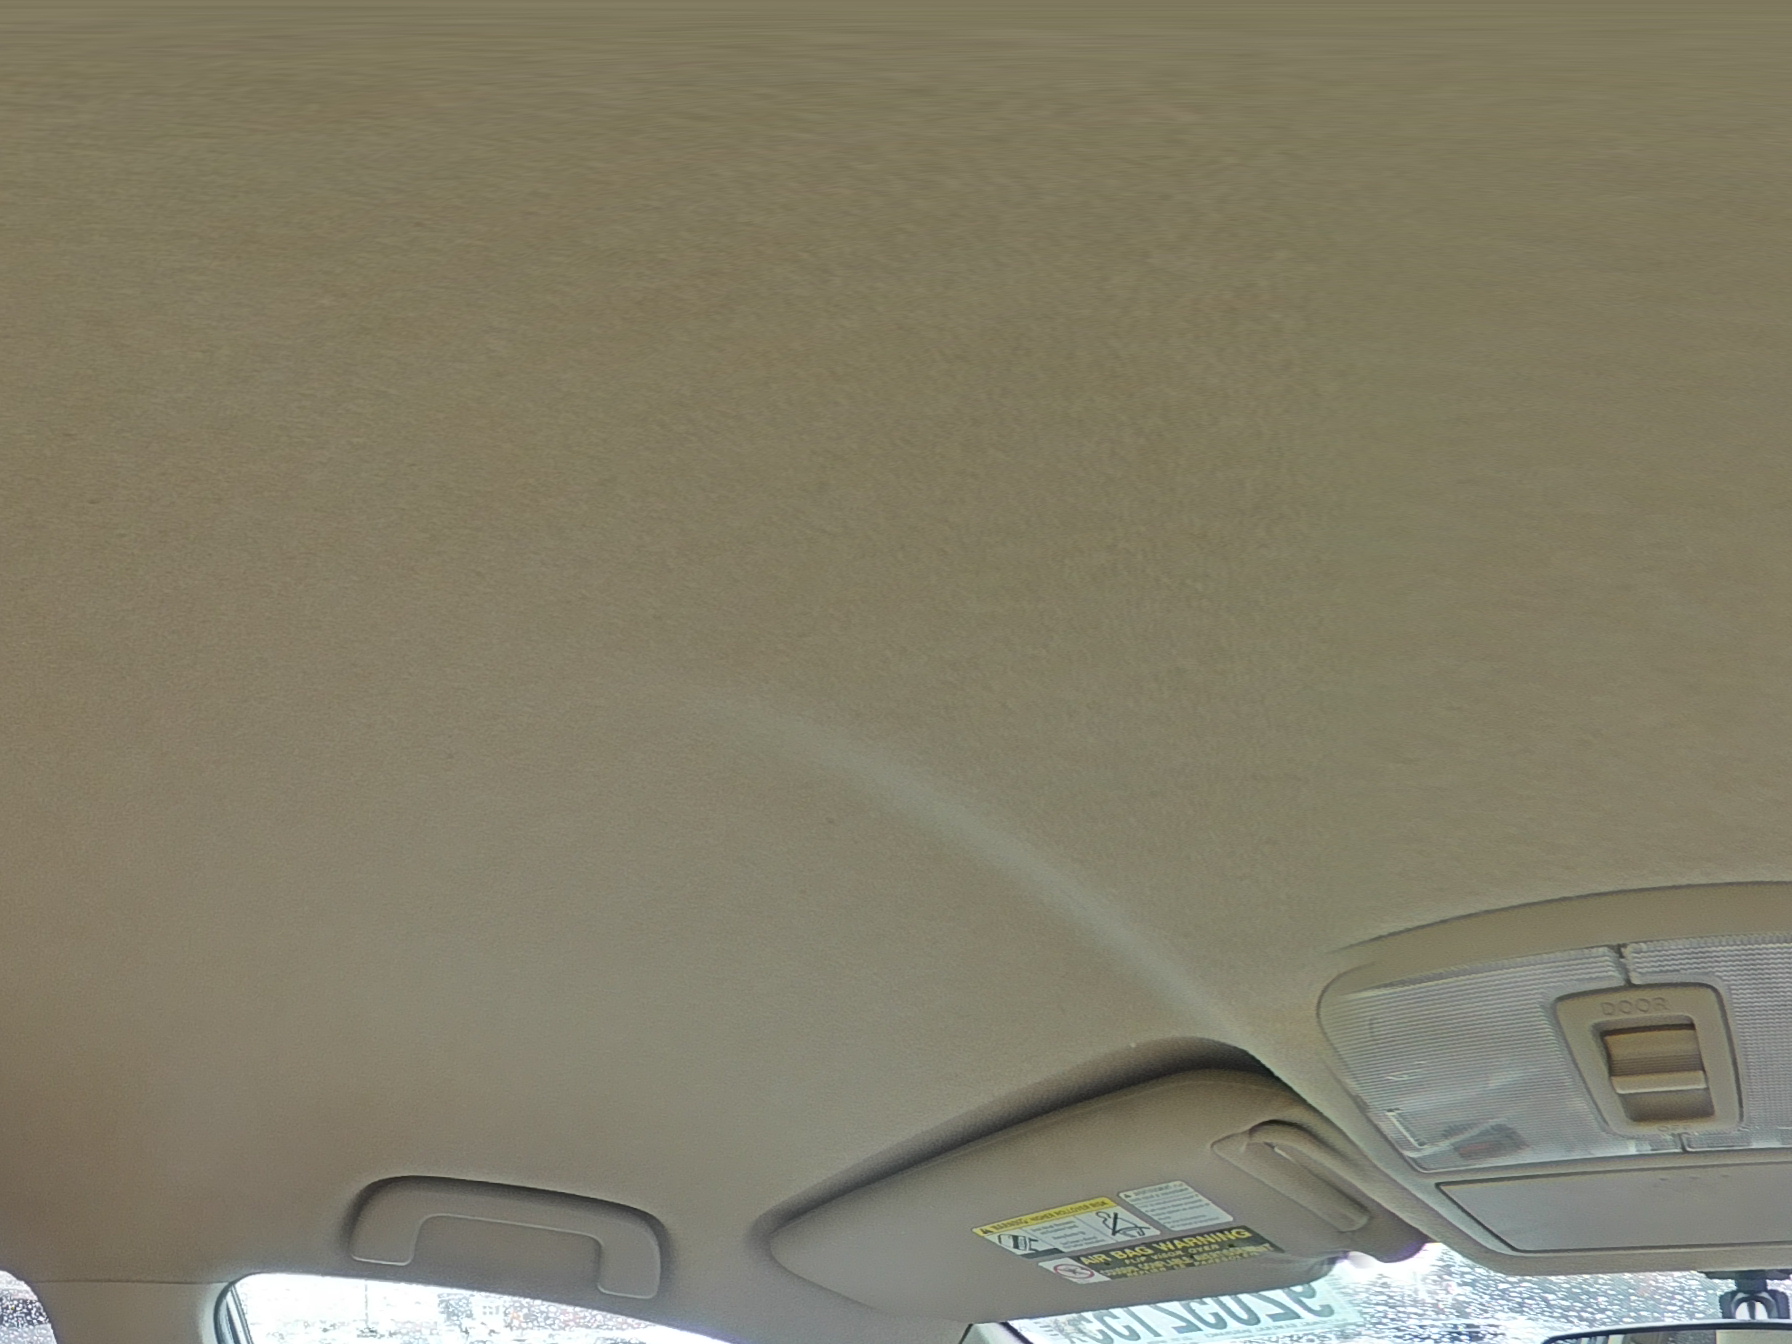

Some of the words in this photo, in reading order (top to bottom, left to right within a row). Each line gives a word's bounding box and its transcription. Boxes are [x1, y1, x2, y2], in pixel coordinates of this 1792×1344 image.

[1601, 997, 1670, 1016] DOOR
[1080, 1254, 1112, 1264] AIR
[1109, 1246, 1154, 1259] BAG
[1152, 1229, 1253, 1251] WARNING
[1188, 1244, 1219, 1254] OVER
